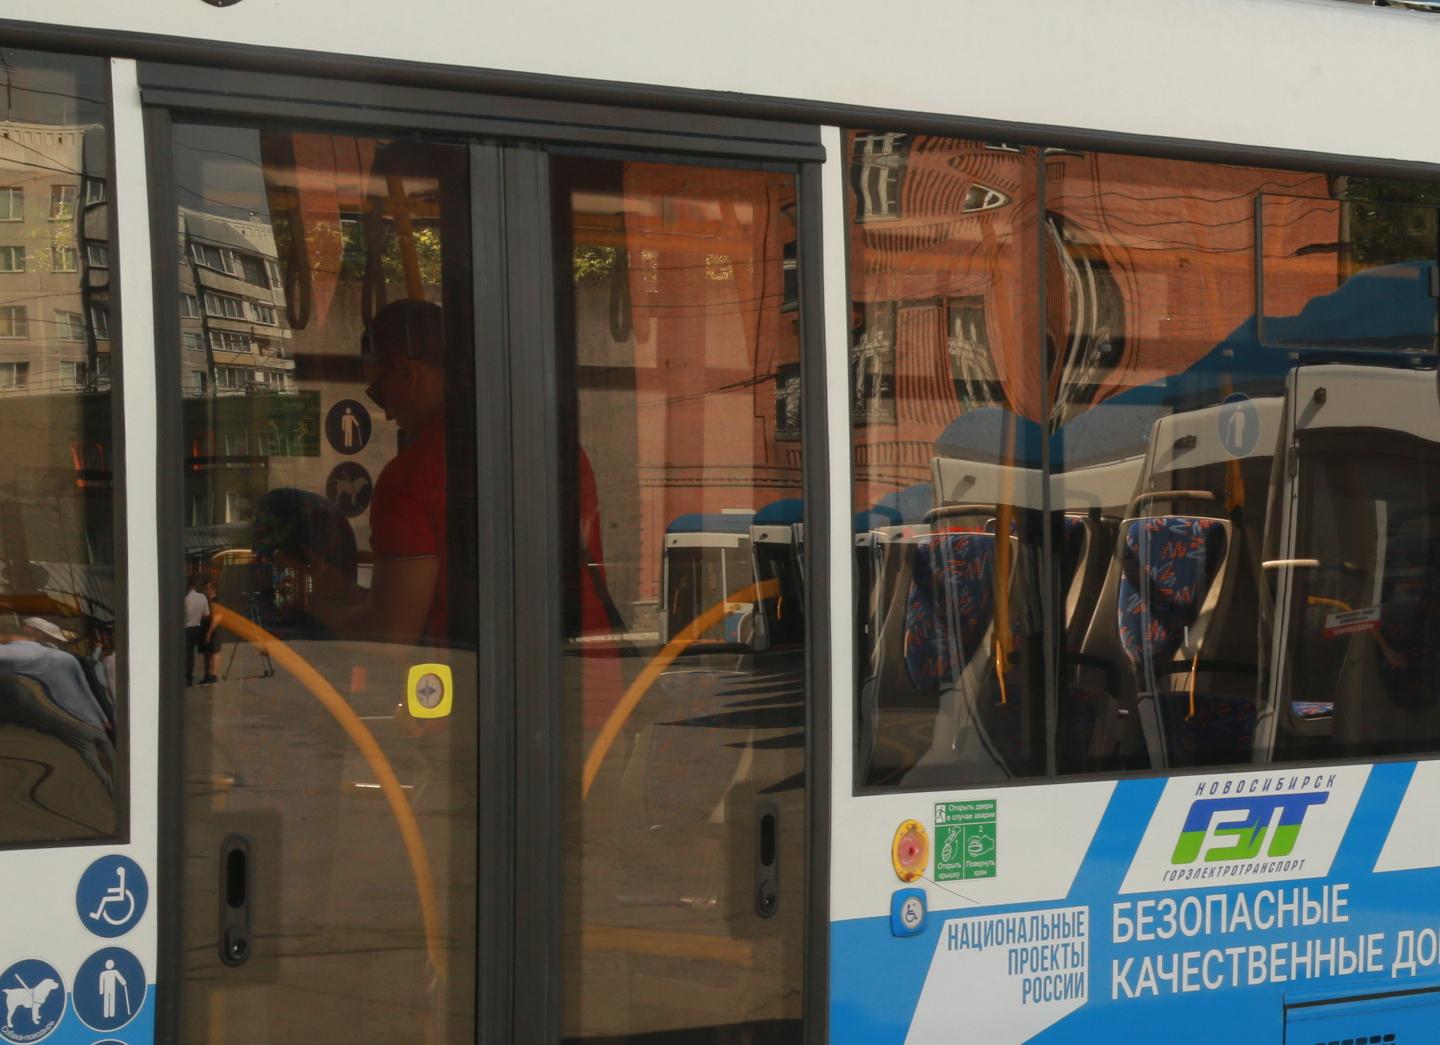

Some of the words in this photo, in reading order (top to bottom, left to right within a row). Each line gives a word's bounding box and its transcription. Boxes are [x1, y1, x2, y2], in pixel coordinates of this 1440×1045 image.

[1195, 774, 1336, 796] НОВОСИБИРСК
[1162, 858, 1306, 882] ГОРЭЛЕКТРОТРАНСПОРТ
[947, 910, 1085, 951] НАЦИОНАЛЬНЫЕ
[1112, 883, 1350, 944] БЕЗОПАСНЫЕ
[1008, 941, 1085, 976] ПРОЕКТЫ
[1112, 933, 1385, 1000] КАЧЕСТВЕННЫЕ
[1022, 971, 1085, 1005] РОССИИ
